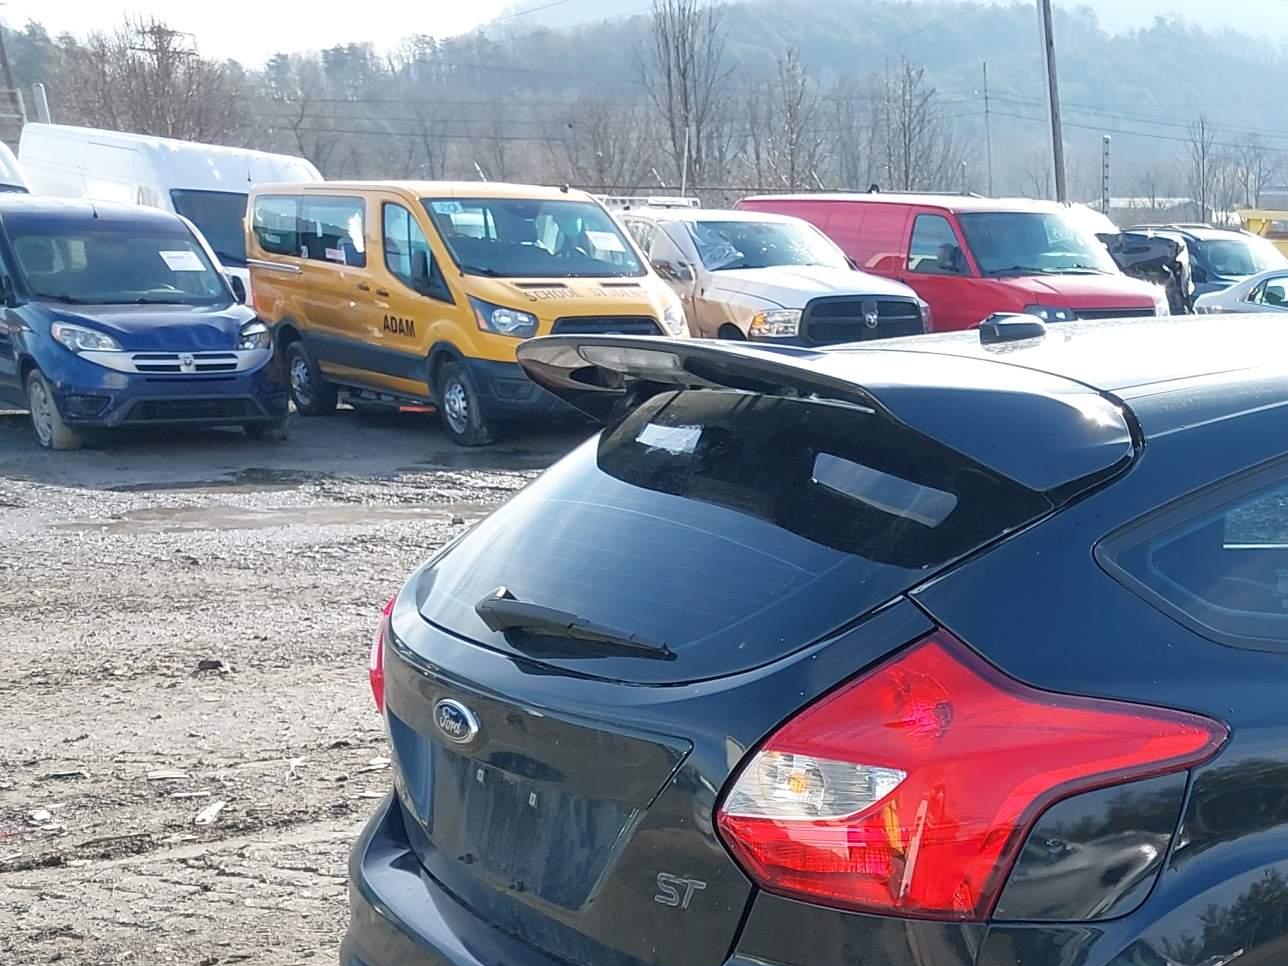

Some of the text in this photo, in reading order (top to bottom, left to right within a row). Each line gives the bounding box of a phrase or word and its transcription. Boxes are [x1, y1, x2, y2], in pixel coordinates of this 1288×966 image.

[524, 287, 584, 302] SCHOOL
[384, 314, 416, 337] ADAM
[440, 706, 464, 735] Ford
[655, 872, 707, 910] ST
